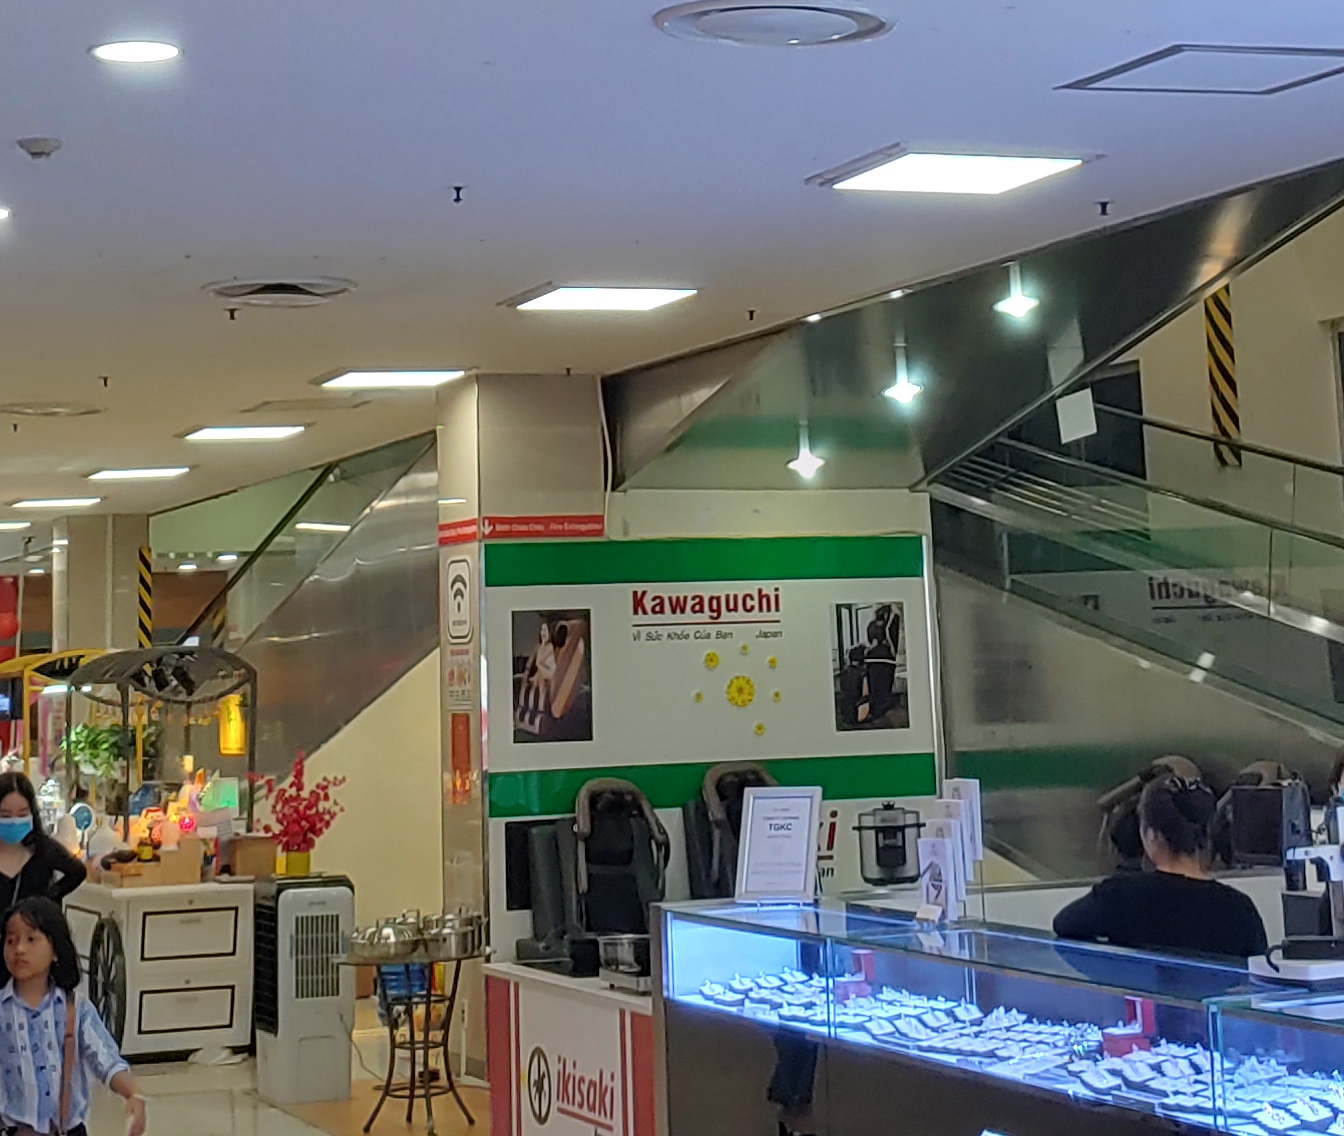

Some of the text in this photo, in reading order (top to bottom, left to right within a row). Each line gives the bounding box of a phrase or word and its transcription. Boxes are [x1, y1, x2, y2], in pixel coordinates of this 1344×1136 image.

[632, 587, 781, 621] Kawaguchi
[755, 629, 783, 641] Japan
[768, 822, 793, 832] TGKC
[557, 1053, 615, 1122] ikisaki
